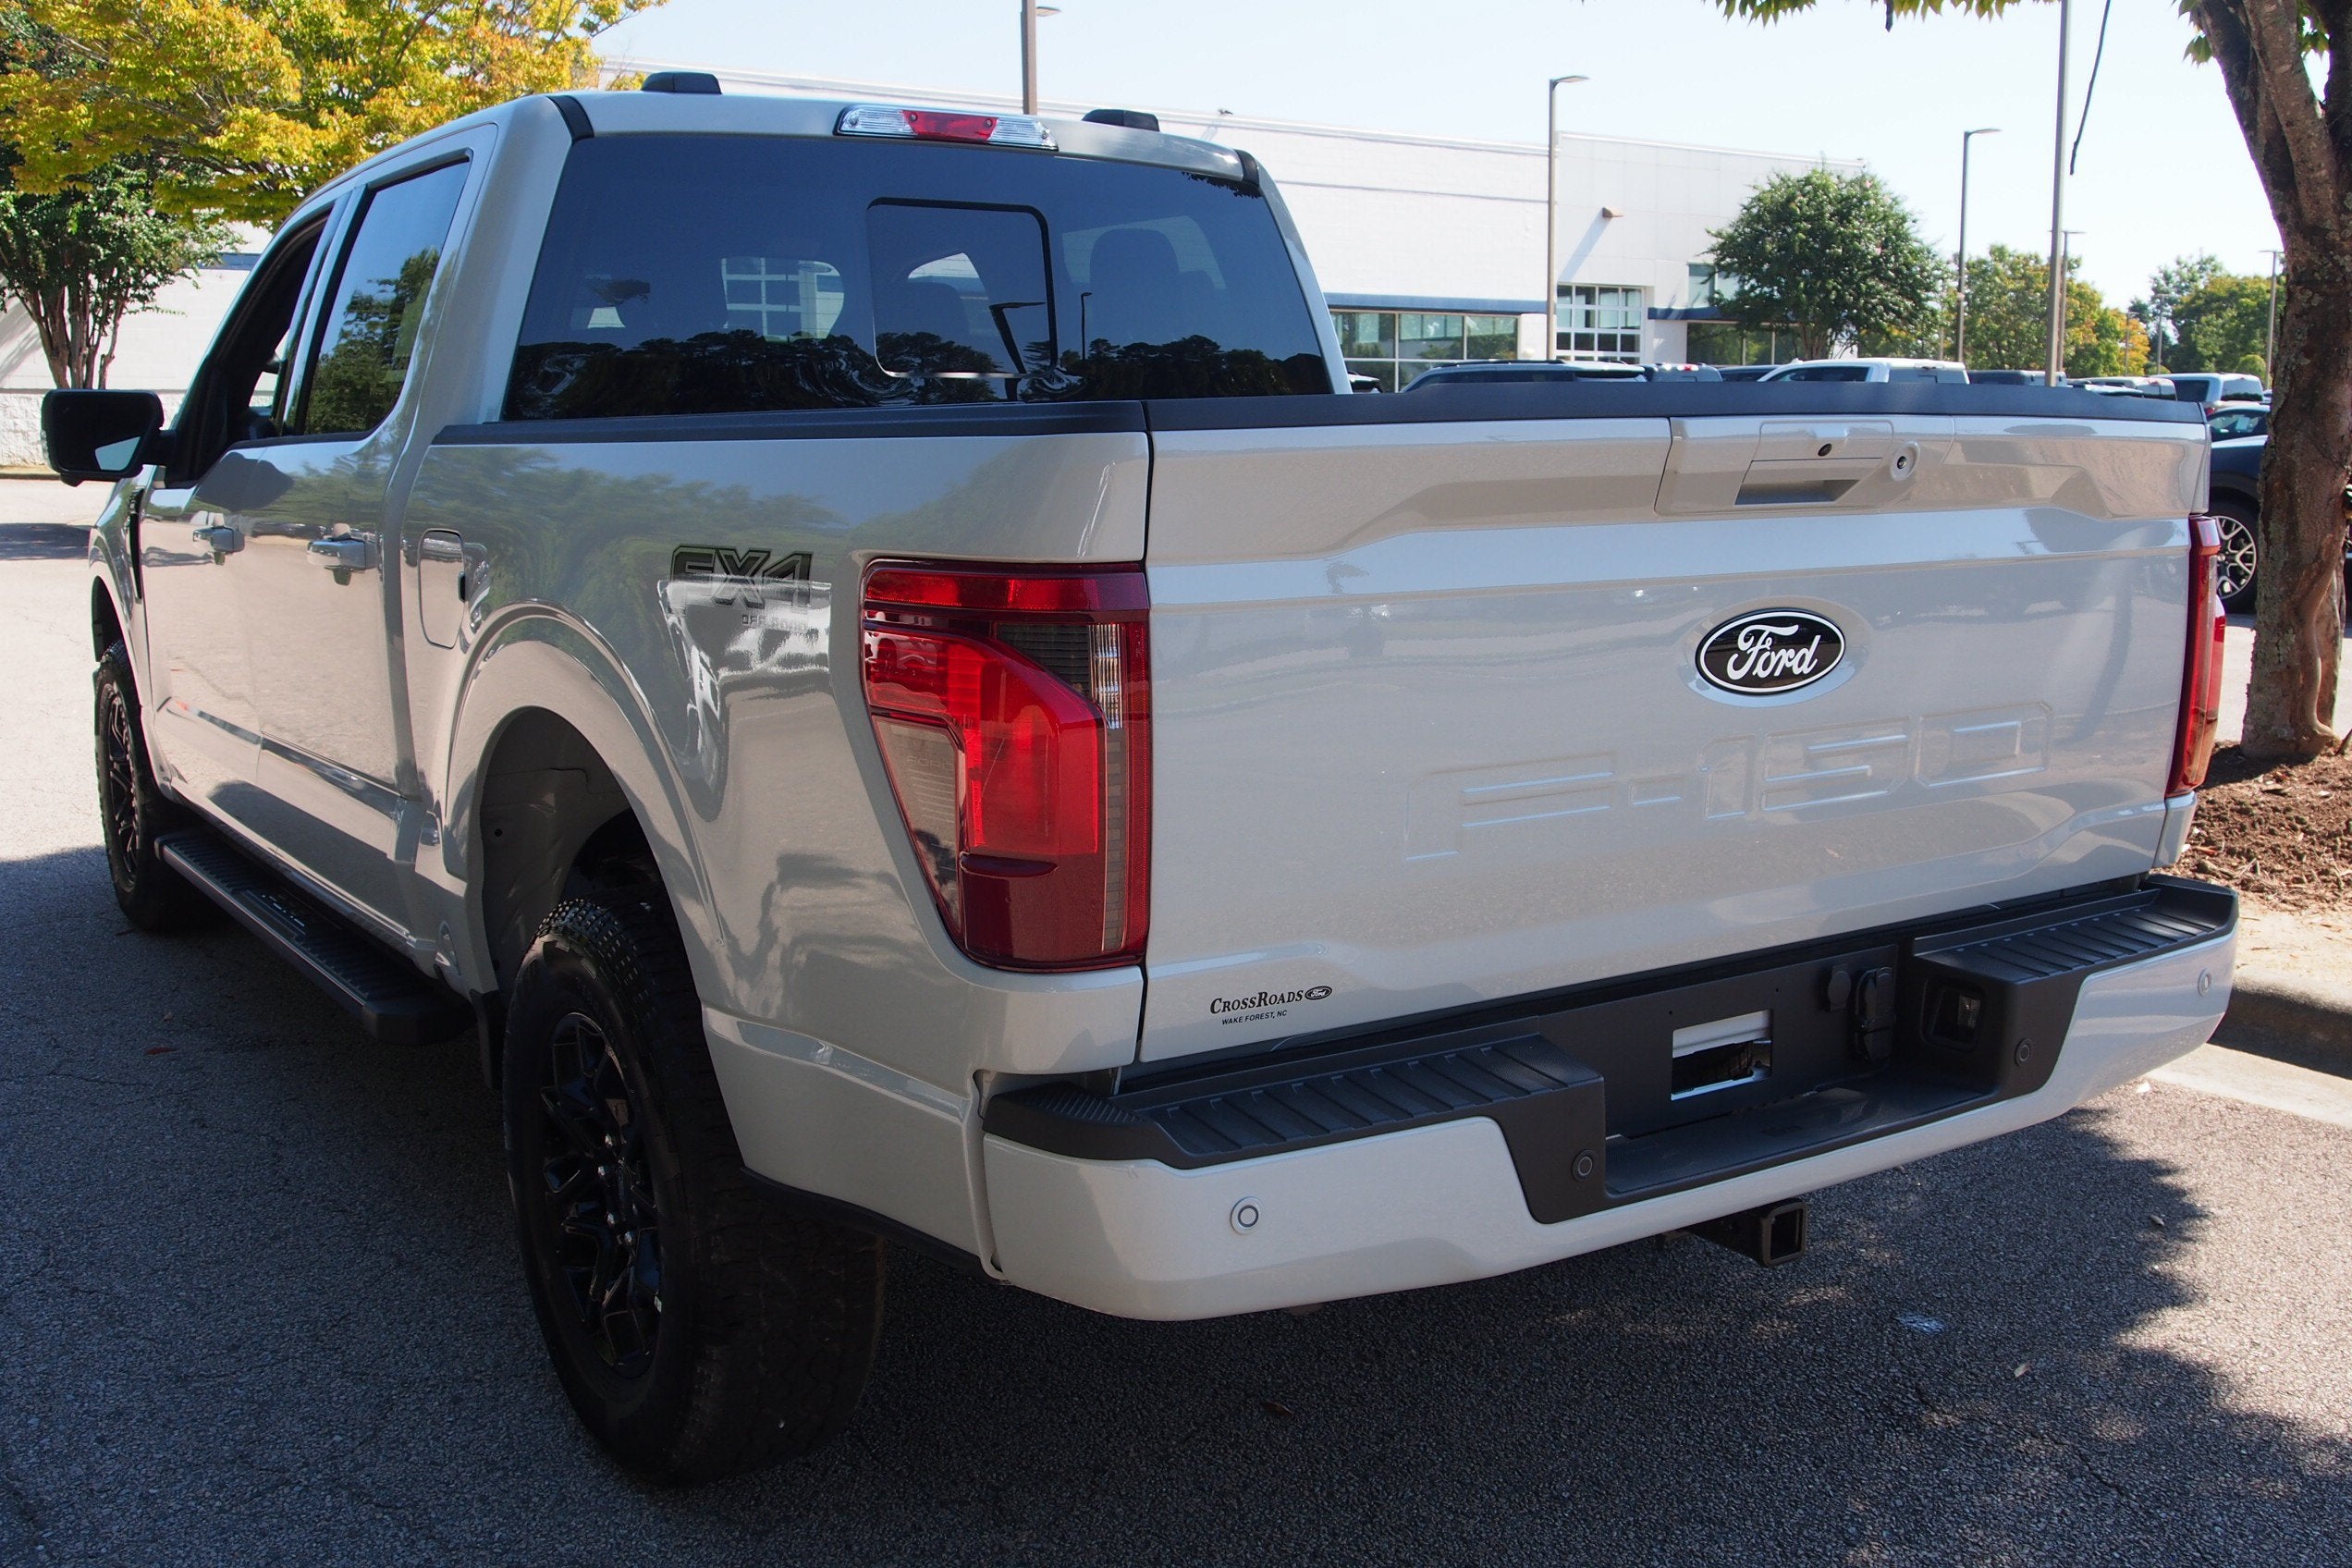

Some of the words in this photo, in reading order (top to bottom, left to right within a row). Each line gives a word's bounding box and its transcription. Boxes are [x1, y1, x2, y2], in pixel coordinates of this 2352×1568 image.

[669, 543, 814, 614] FX4
[1726, 624, 1821, 680] Ford
[1404, 700, 2054, 862] F-150
[1221, 1016, 1243, 1025] WAKE
[1244, 1011, 1275, 1022] FOREST,
[1276, 1010, 1288, 1018] NC
